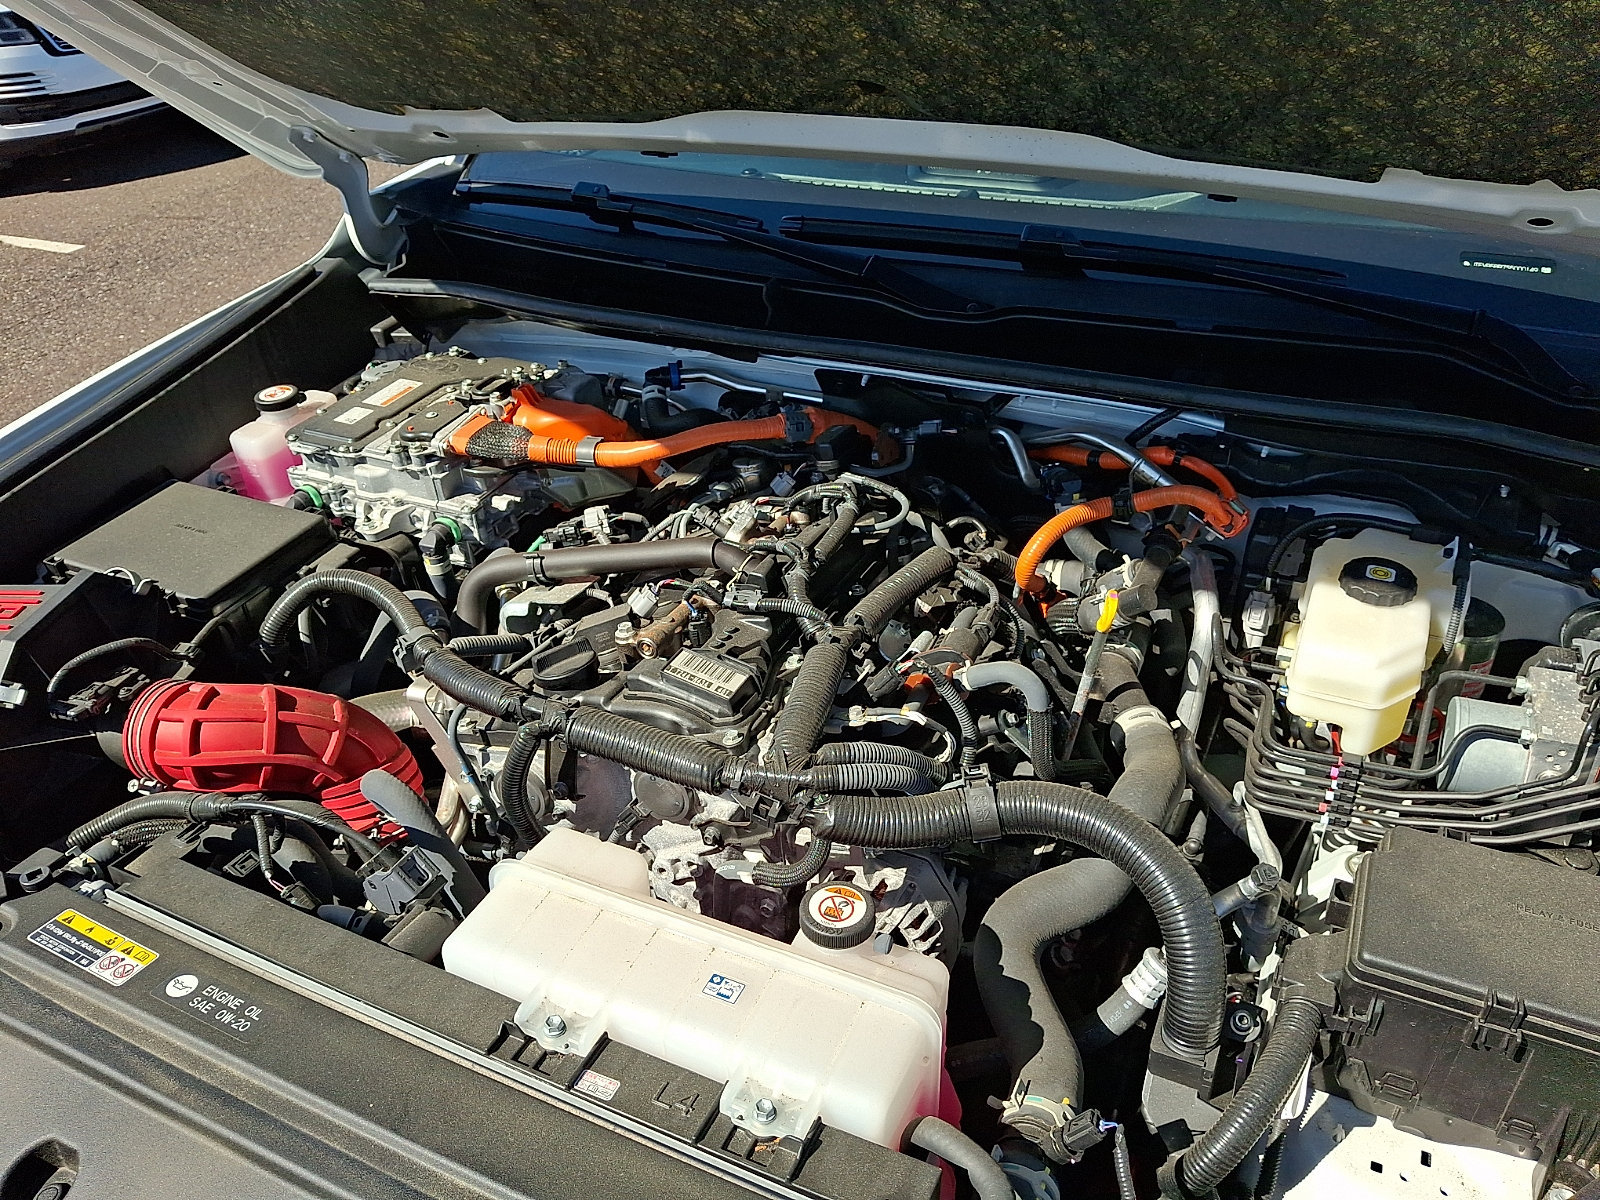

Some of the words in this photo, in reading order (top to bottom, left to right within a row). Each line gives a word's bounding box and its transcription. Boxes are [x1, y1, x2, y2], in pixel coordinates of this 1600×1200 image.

[188, 996, 216, 1014] SAE
[214, 1009, 251, 1032] 0W-20
[201, 984, 245, 1010] ENGINE
[244, 1005, 263, 1021] OIL
[652, 1081, 700, 1118] L4
